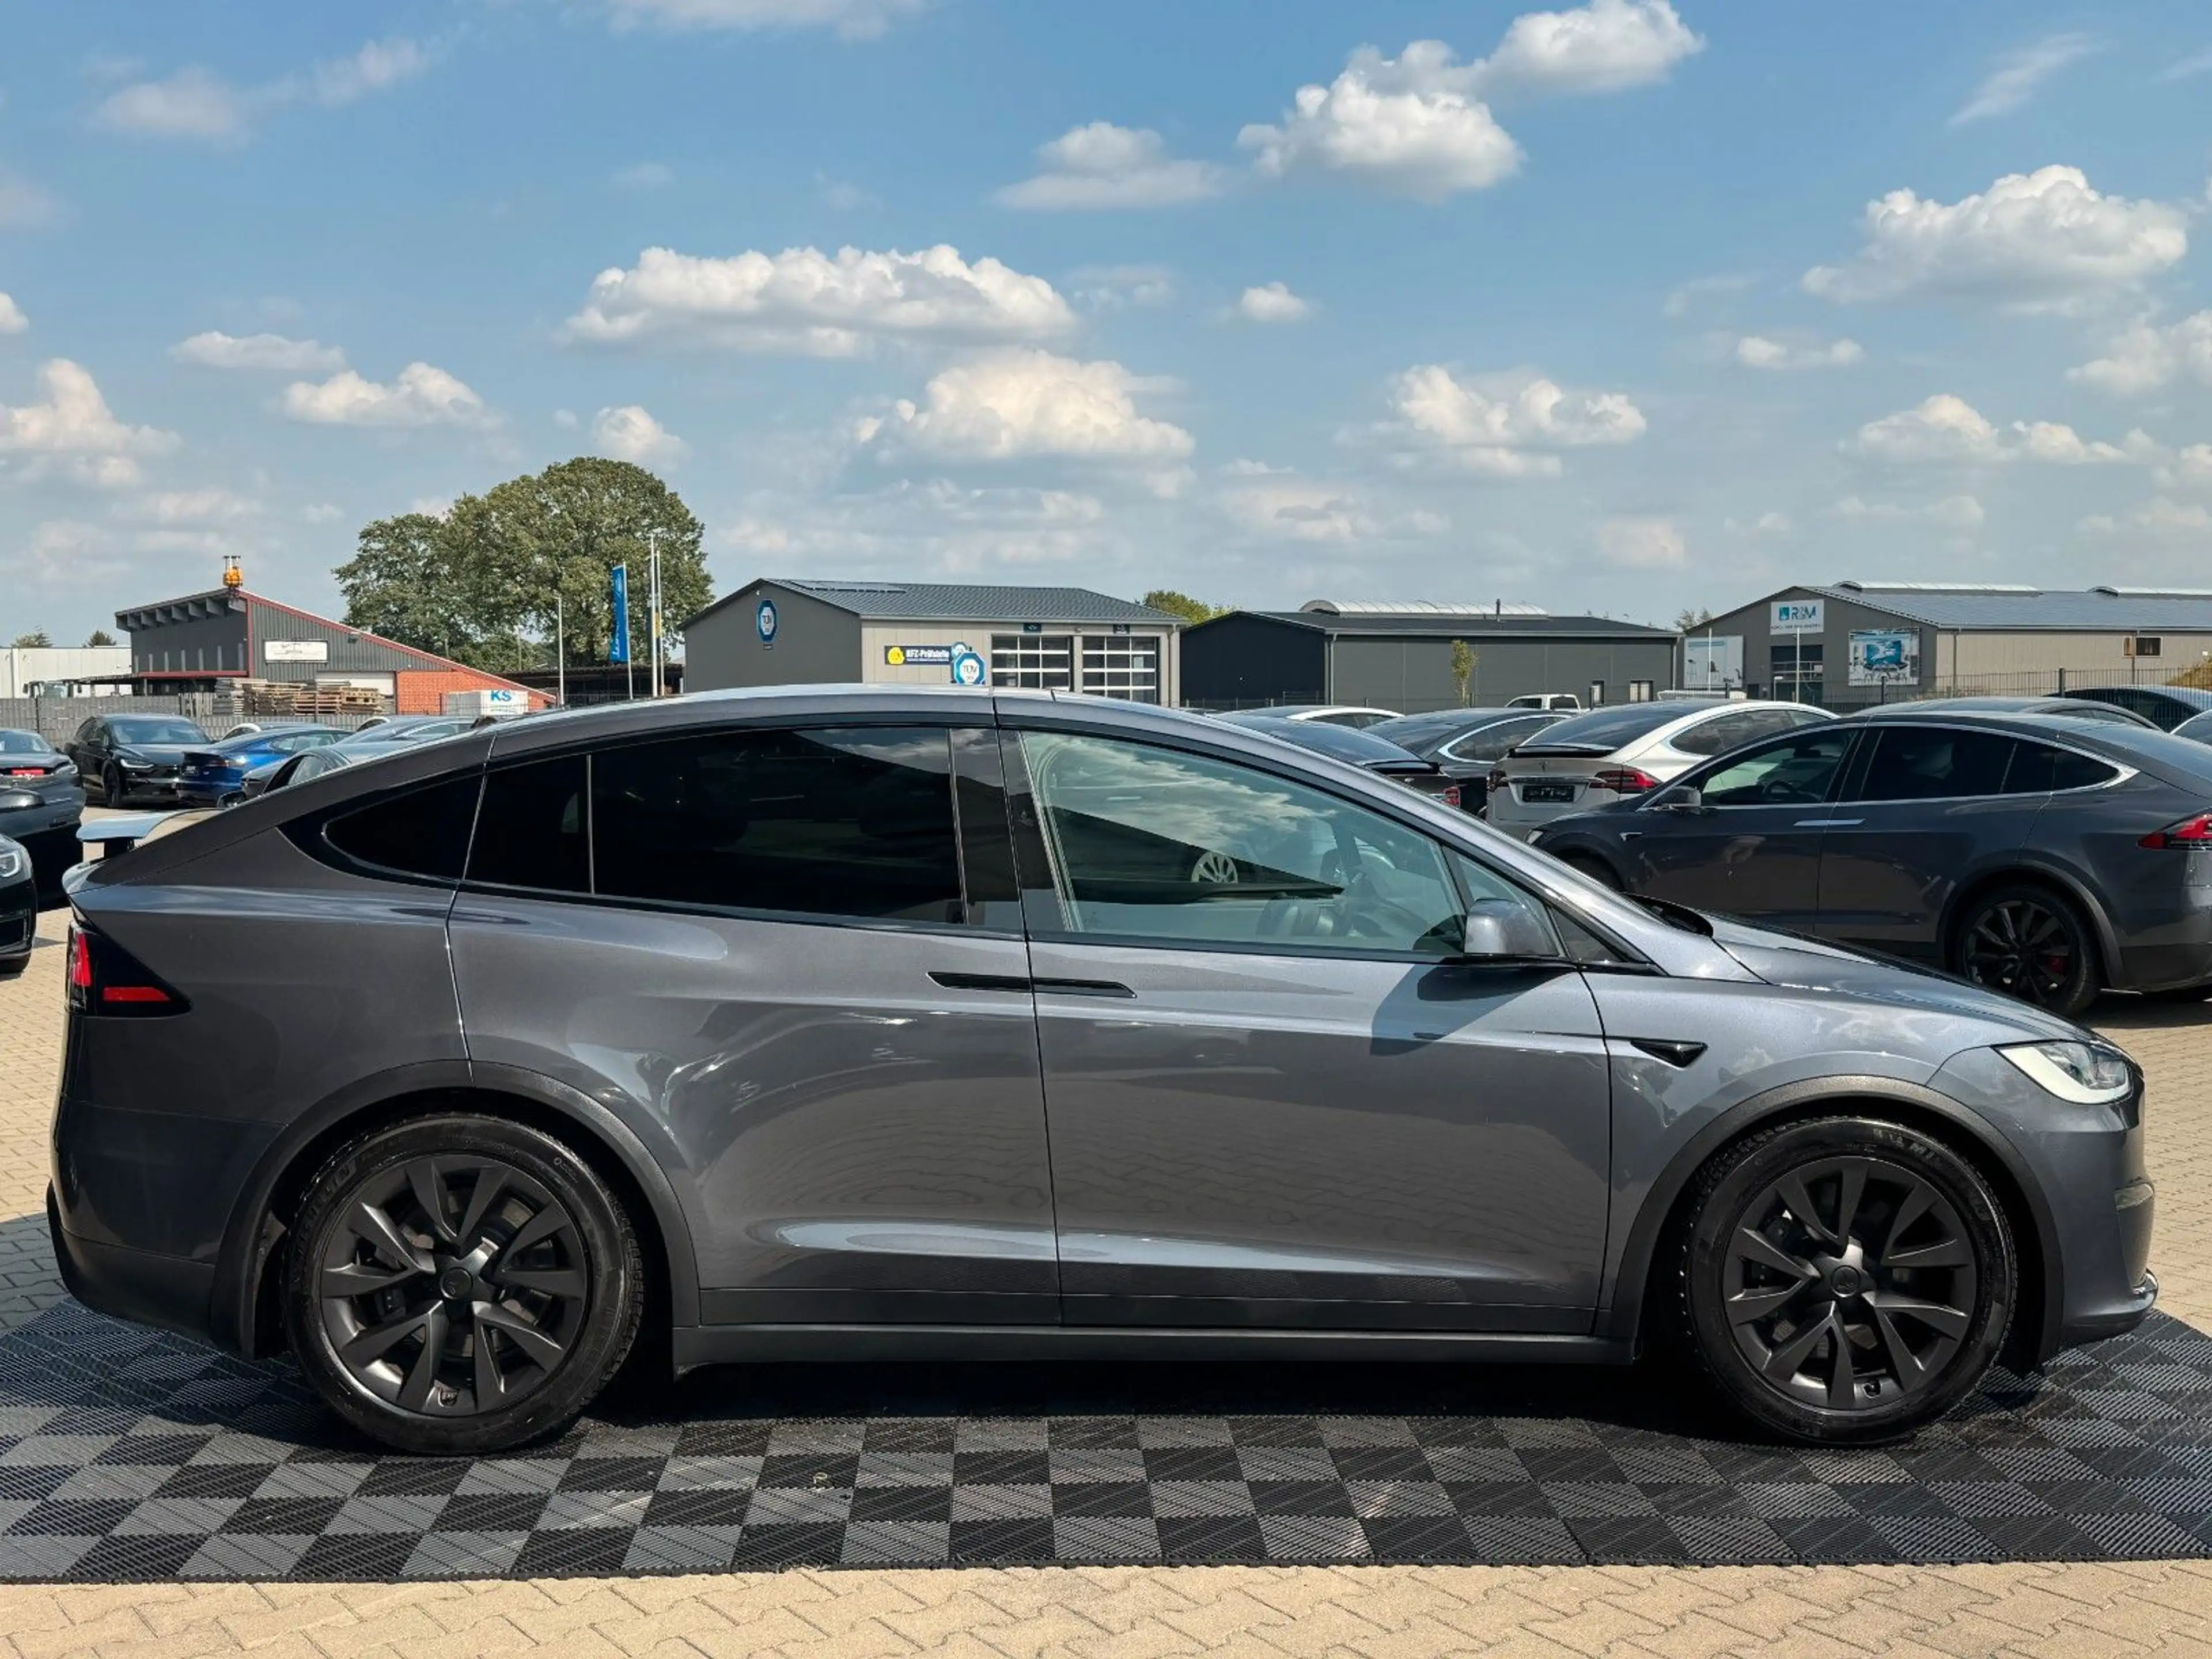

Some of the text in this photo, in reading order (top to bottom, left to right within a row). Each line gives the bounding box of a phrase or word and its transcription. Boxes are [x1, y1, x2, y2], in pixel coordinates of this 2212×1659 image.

[1791, 605, 1816, 620] R&M
[963, 664, 978, 673] TÜV
[491, 690, 512, 701] KS
